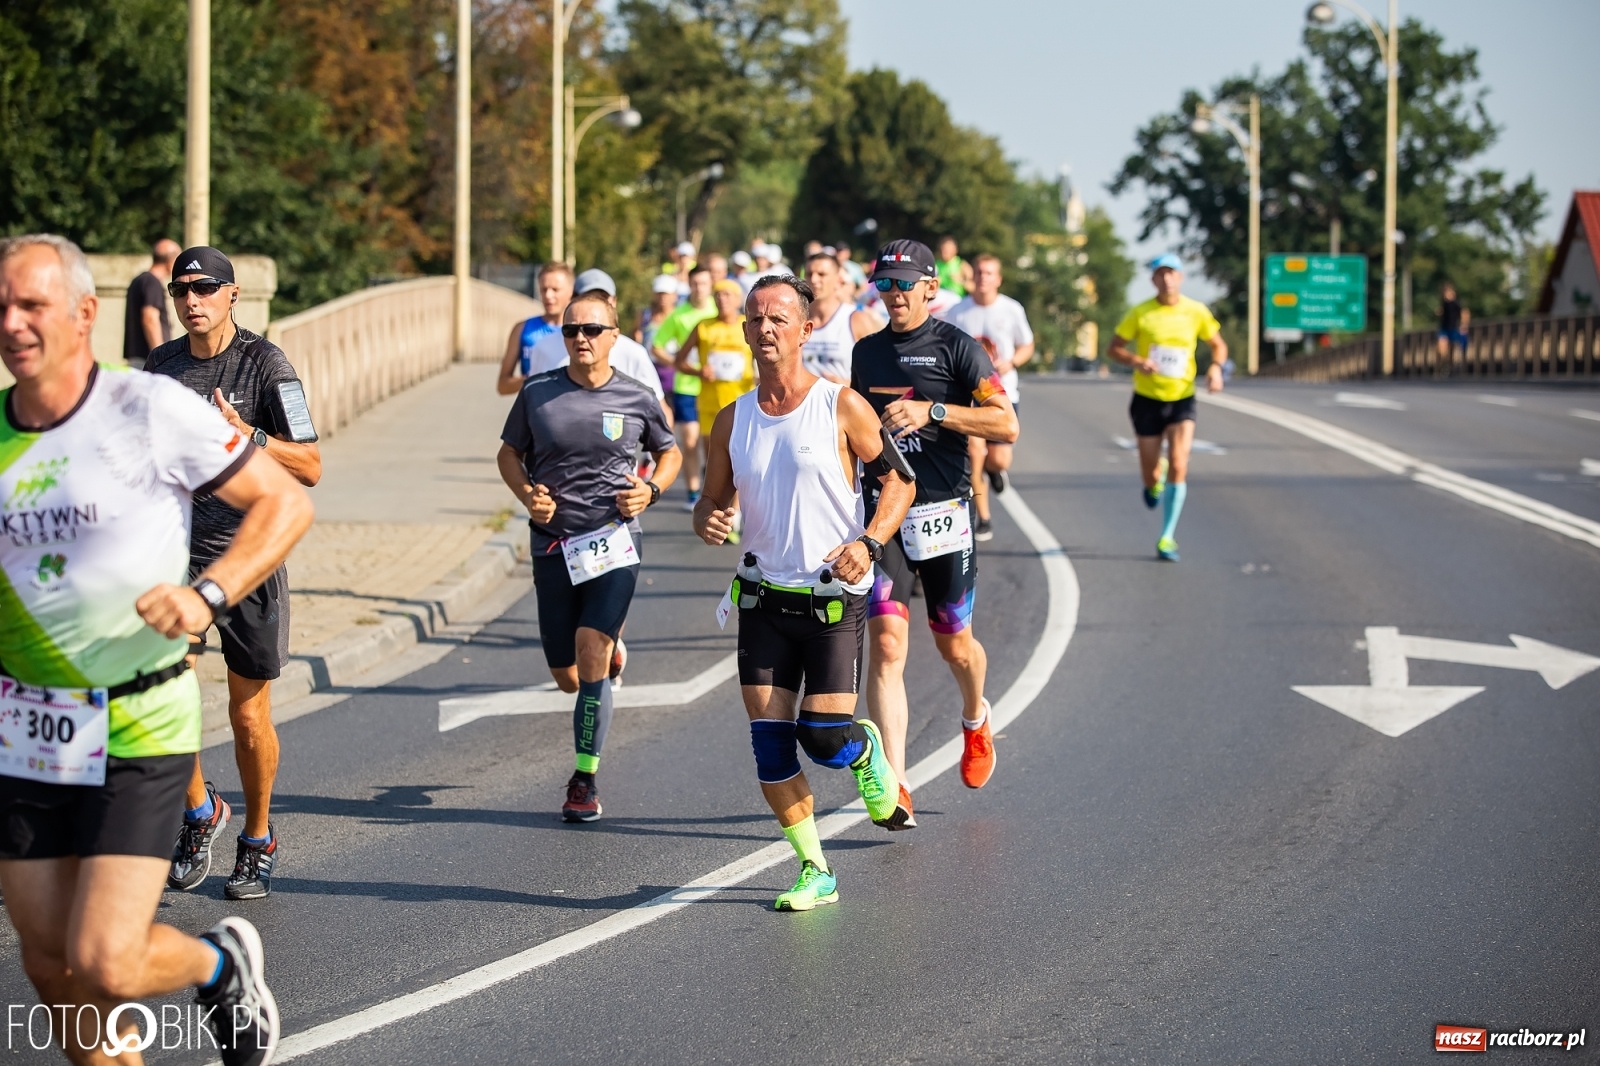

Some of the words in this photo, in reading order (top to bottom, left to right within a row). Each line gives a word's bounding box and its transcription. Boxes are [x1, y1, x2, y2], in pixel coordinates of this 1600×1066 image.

[0, 503, 98, 536] KTYWNI
[921, 515, 953, 537] 459
[589, 537, 610, 556] 93
[28, 709, 75, 744] 300
